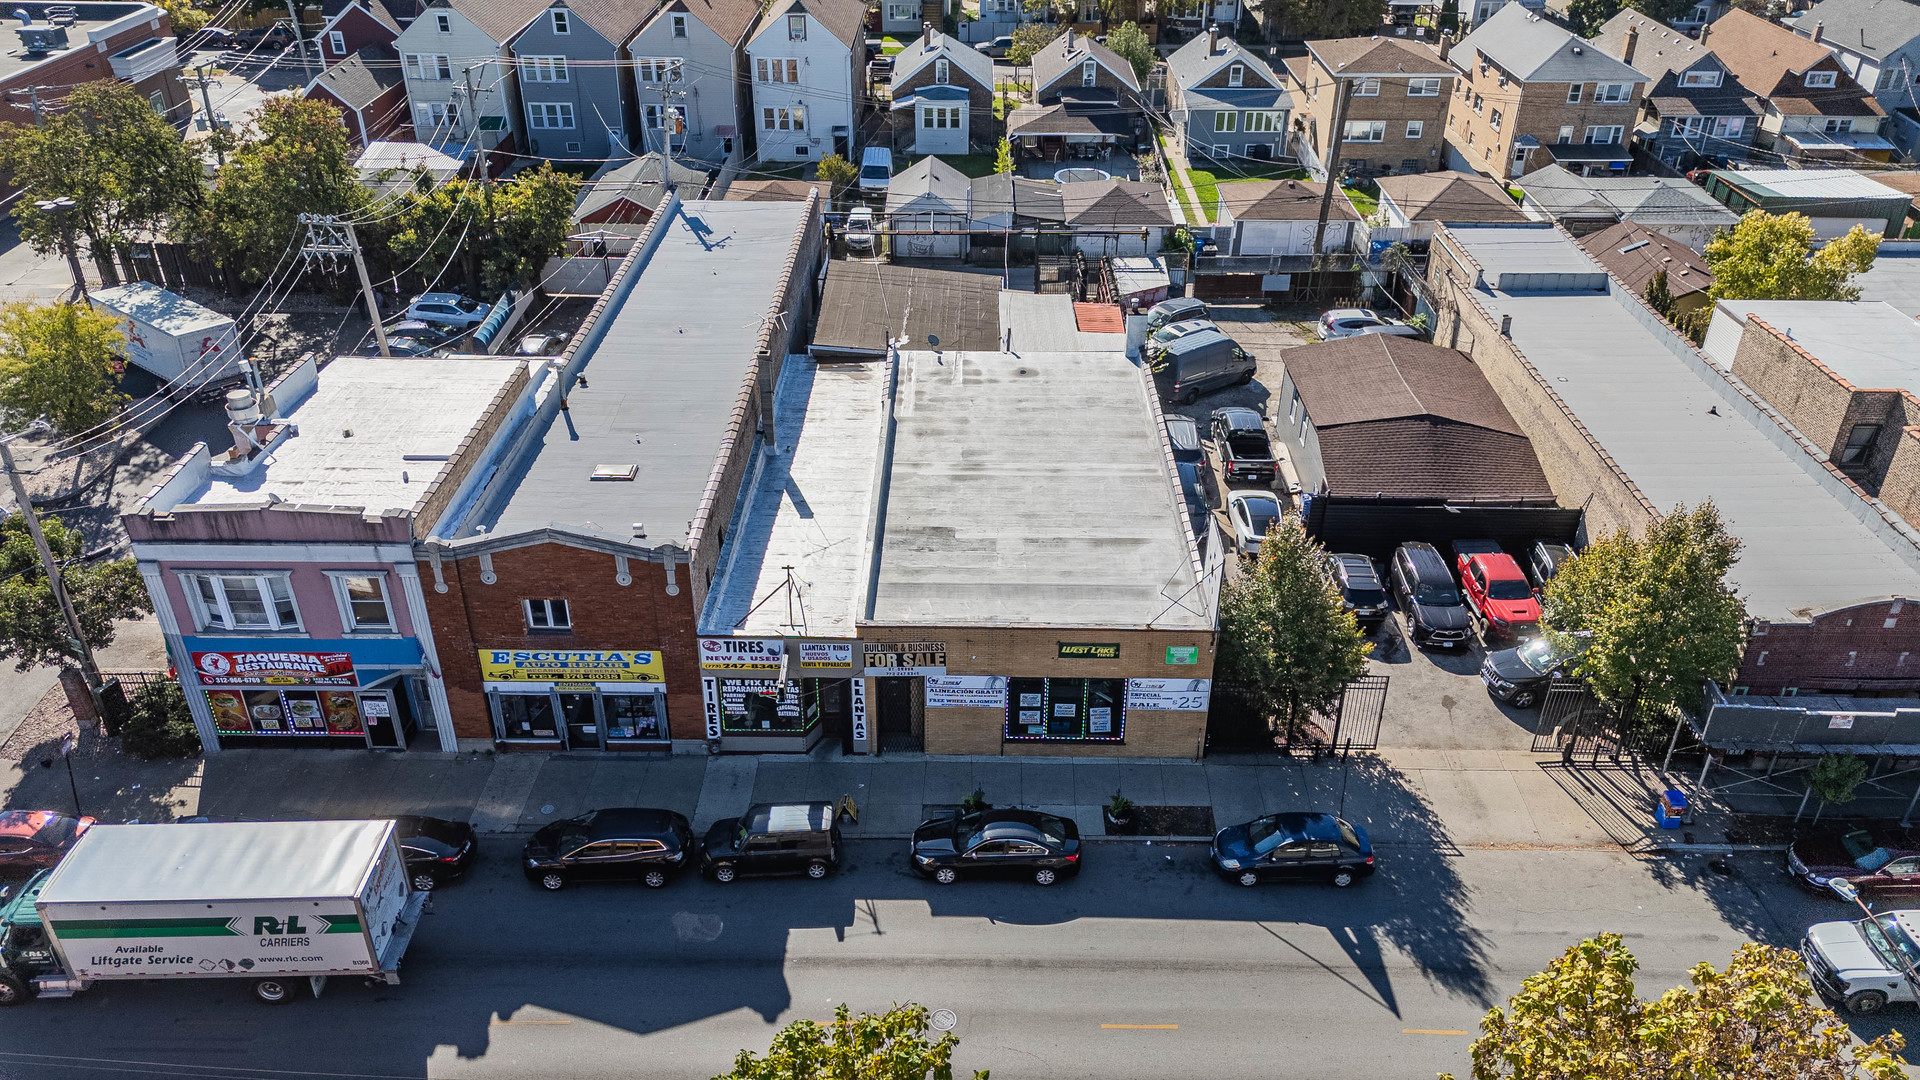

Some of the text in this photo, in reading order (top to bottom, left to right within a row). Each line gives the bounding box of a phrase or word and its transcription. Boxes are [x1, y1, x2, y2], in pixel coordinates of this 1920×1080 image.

[723, 641, 764, 653] TIRES
[864, 643, 945, 652] BUILDING & BUSINESS
[1091, 646, 1115, 654] LAKE
[233, 653, 321, 664] TAQUERIA
[490, 651, 652, 665] ESCUTIA'S
[865, 653, 945, 667] FOR SALE
[235, 661, 327, 673] RESTAURANTE
[703, 679, 718, 736] TIRES
[854, 679, 865, 738] LLANTAS
[260, 938, 310, 947] CARRIERS
[115, 945, 164, 953] Available
[91, 955, 194, 967] Liftgate Service
[258, 955, 324, 963] www.rlc.com
